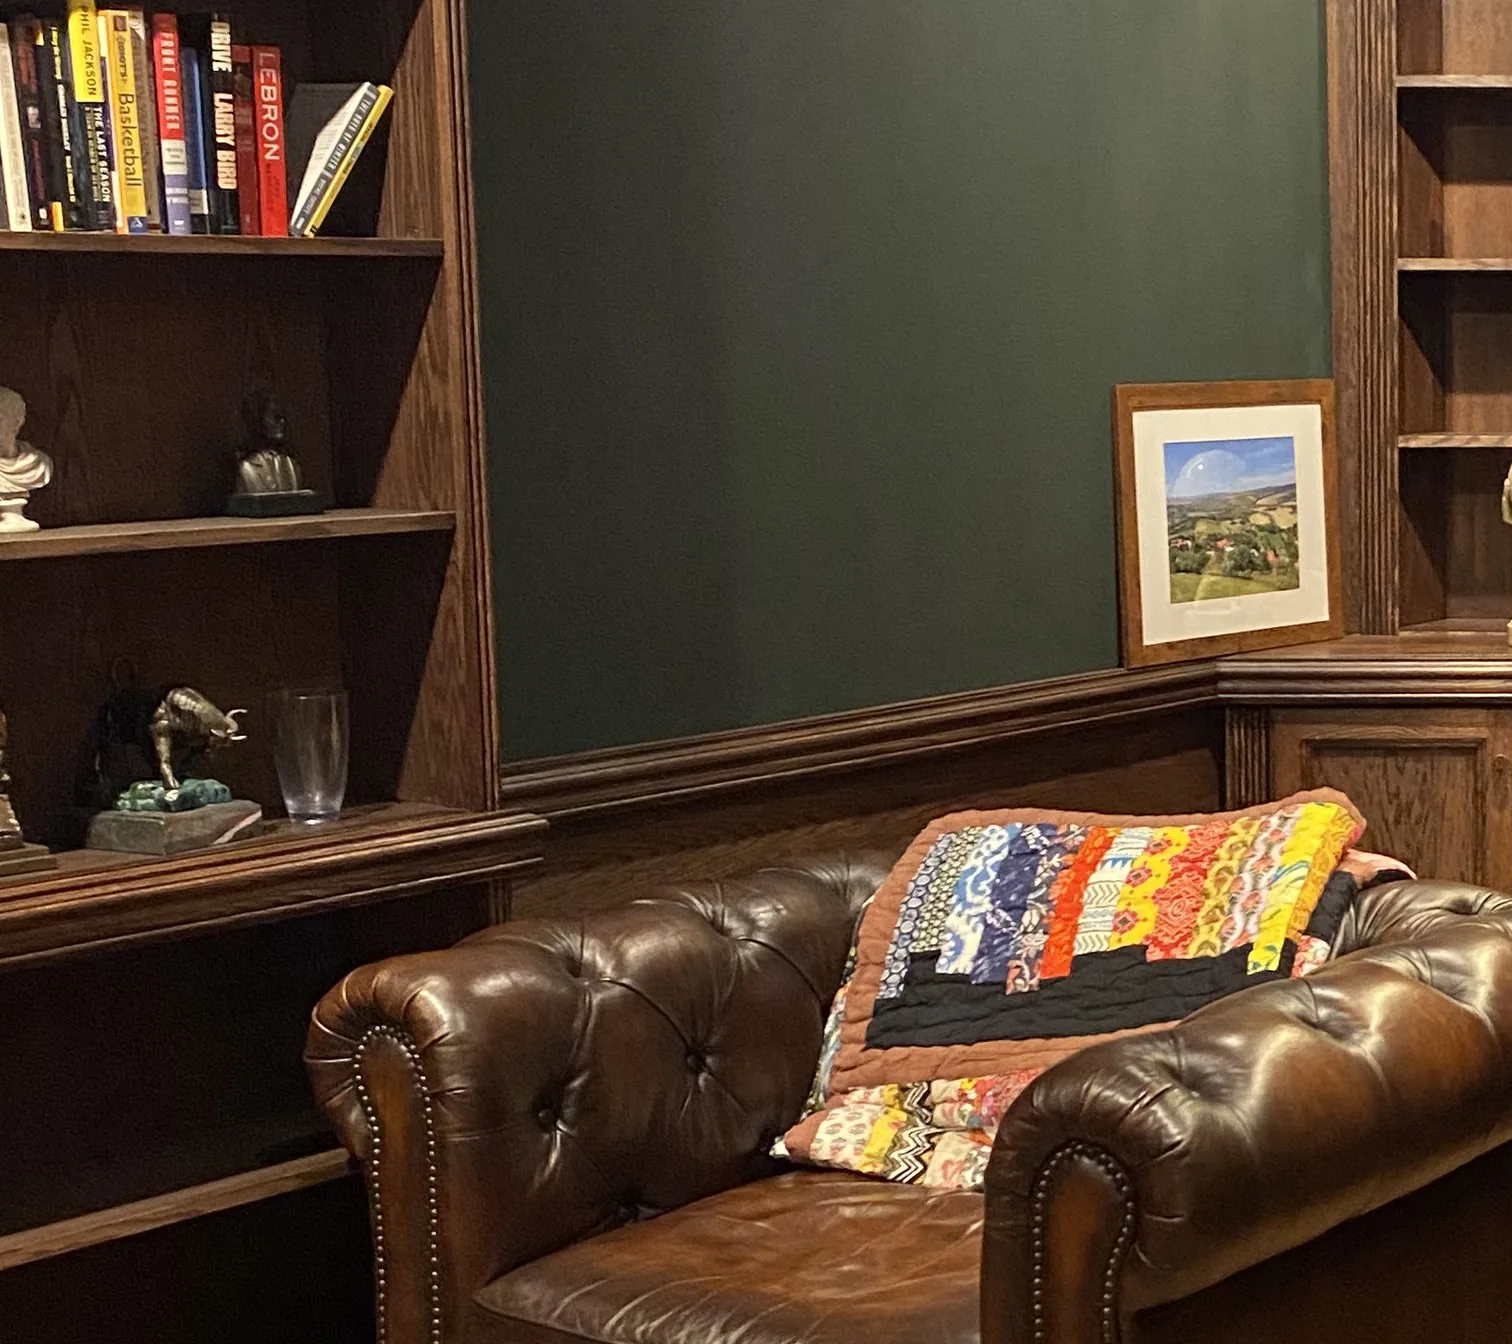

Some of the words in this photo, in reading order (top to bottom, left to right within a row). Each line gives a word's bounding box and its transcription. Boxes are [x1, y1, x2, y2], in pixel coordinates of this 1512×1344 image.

[79, 5, 94, 35] PHIL
[82, 39, 97, 96] JACKSON
[159, 31, 177, 74] FRONT
[210, 21, 232, 73] DRIVE
[92, 106, 103, 128] THE
[163, 79, 181, 130] RUNNER
[213, 93, 236, 146] LARRY
[259, 53, 280, 160] LEBRON
[95, 131, 106, 158] LAST
[117, 93, 142, 187] Basketball
[98, 160, 110, 202] SEASON
[216, 150, 237, 190] BIRD
